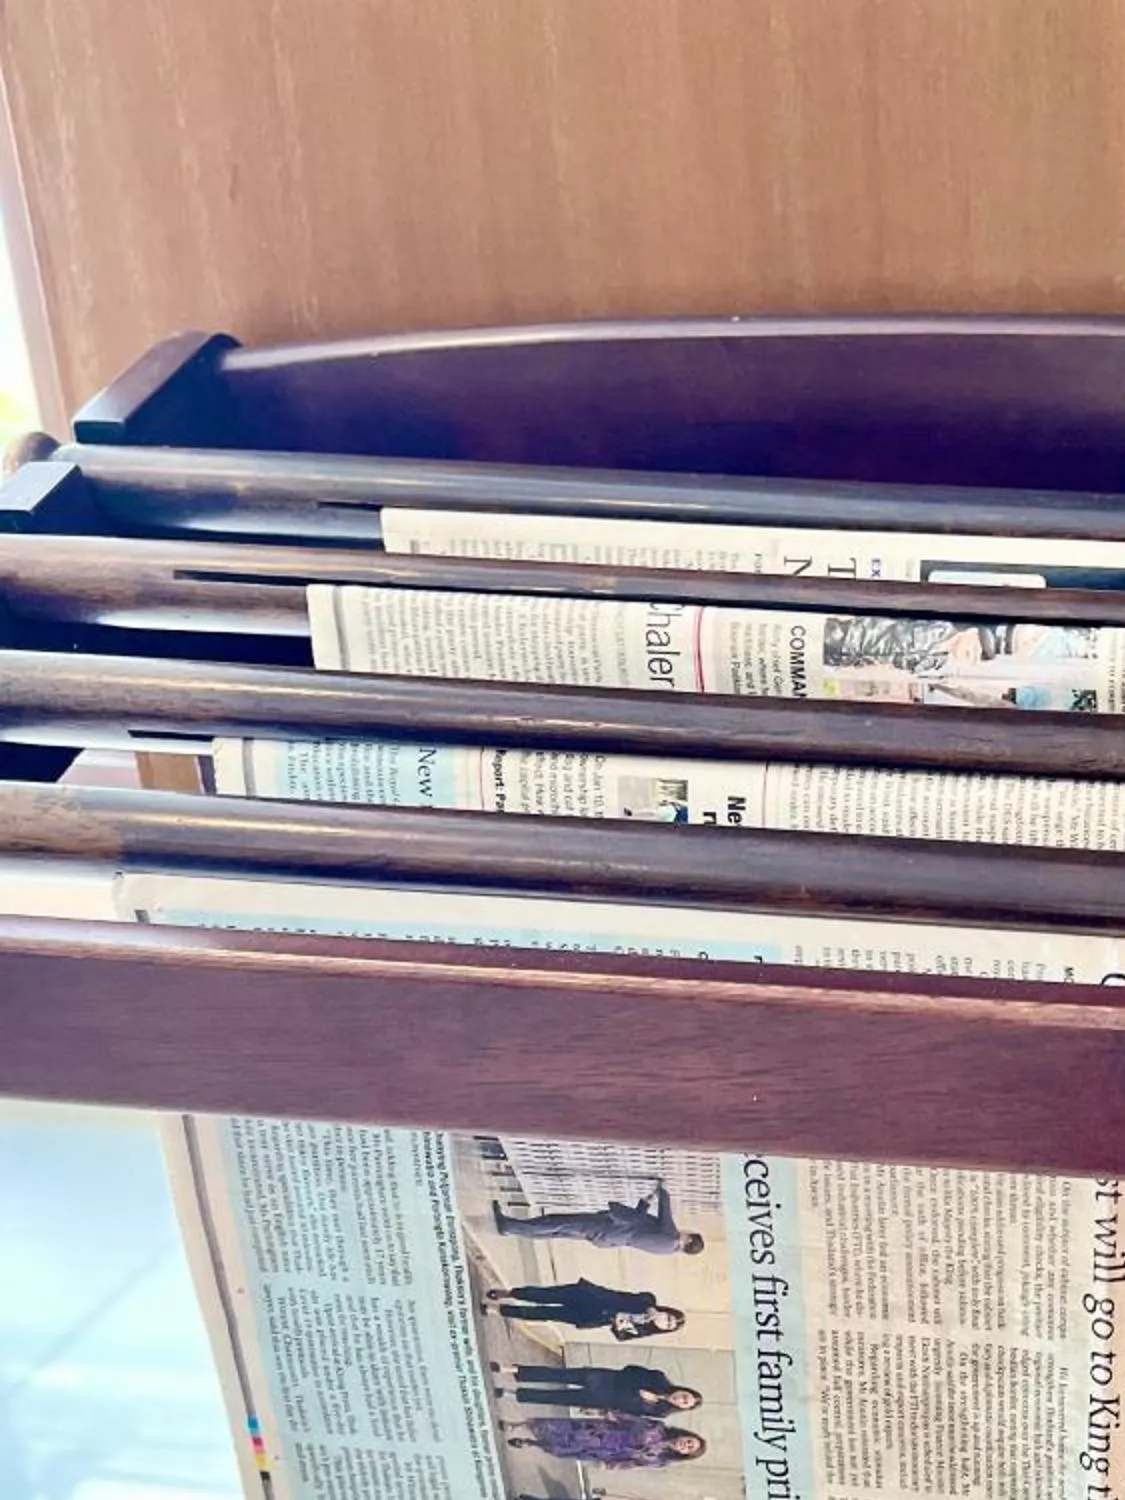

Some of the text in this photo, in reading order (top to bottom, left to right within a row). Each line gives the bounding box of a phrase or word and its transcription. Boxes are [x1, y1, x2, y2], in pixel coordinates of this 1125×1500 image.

[416, 748, 437, 798] New
[728, 796, 746, 826] Ne
[743, 1159, 782, 1265] ceives
[752, 1273, 789, 1342] first
[1083, 1293, 1117, 1340] go
[1089, 1351, 1117, 1386] to
[753, 1349, 797, 1453] family
[1079, 1393, 1121, 1477] King
